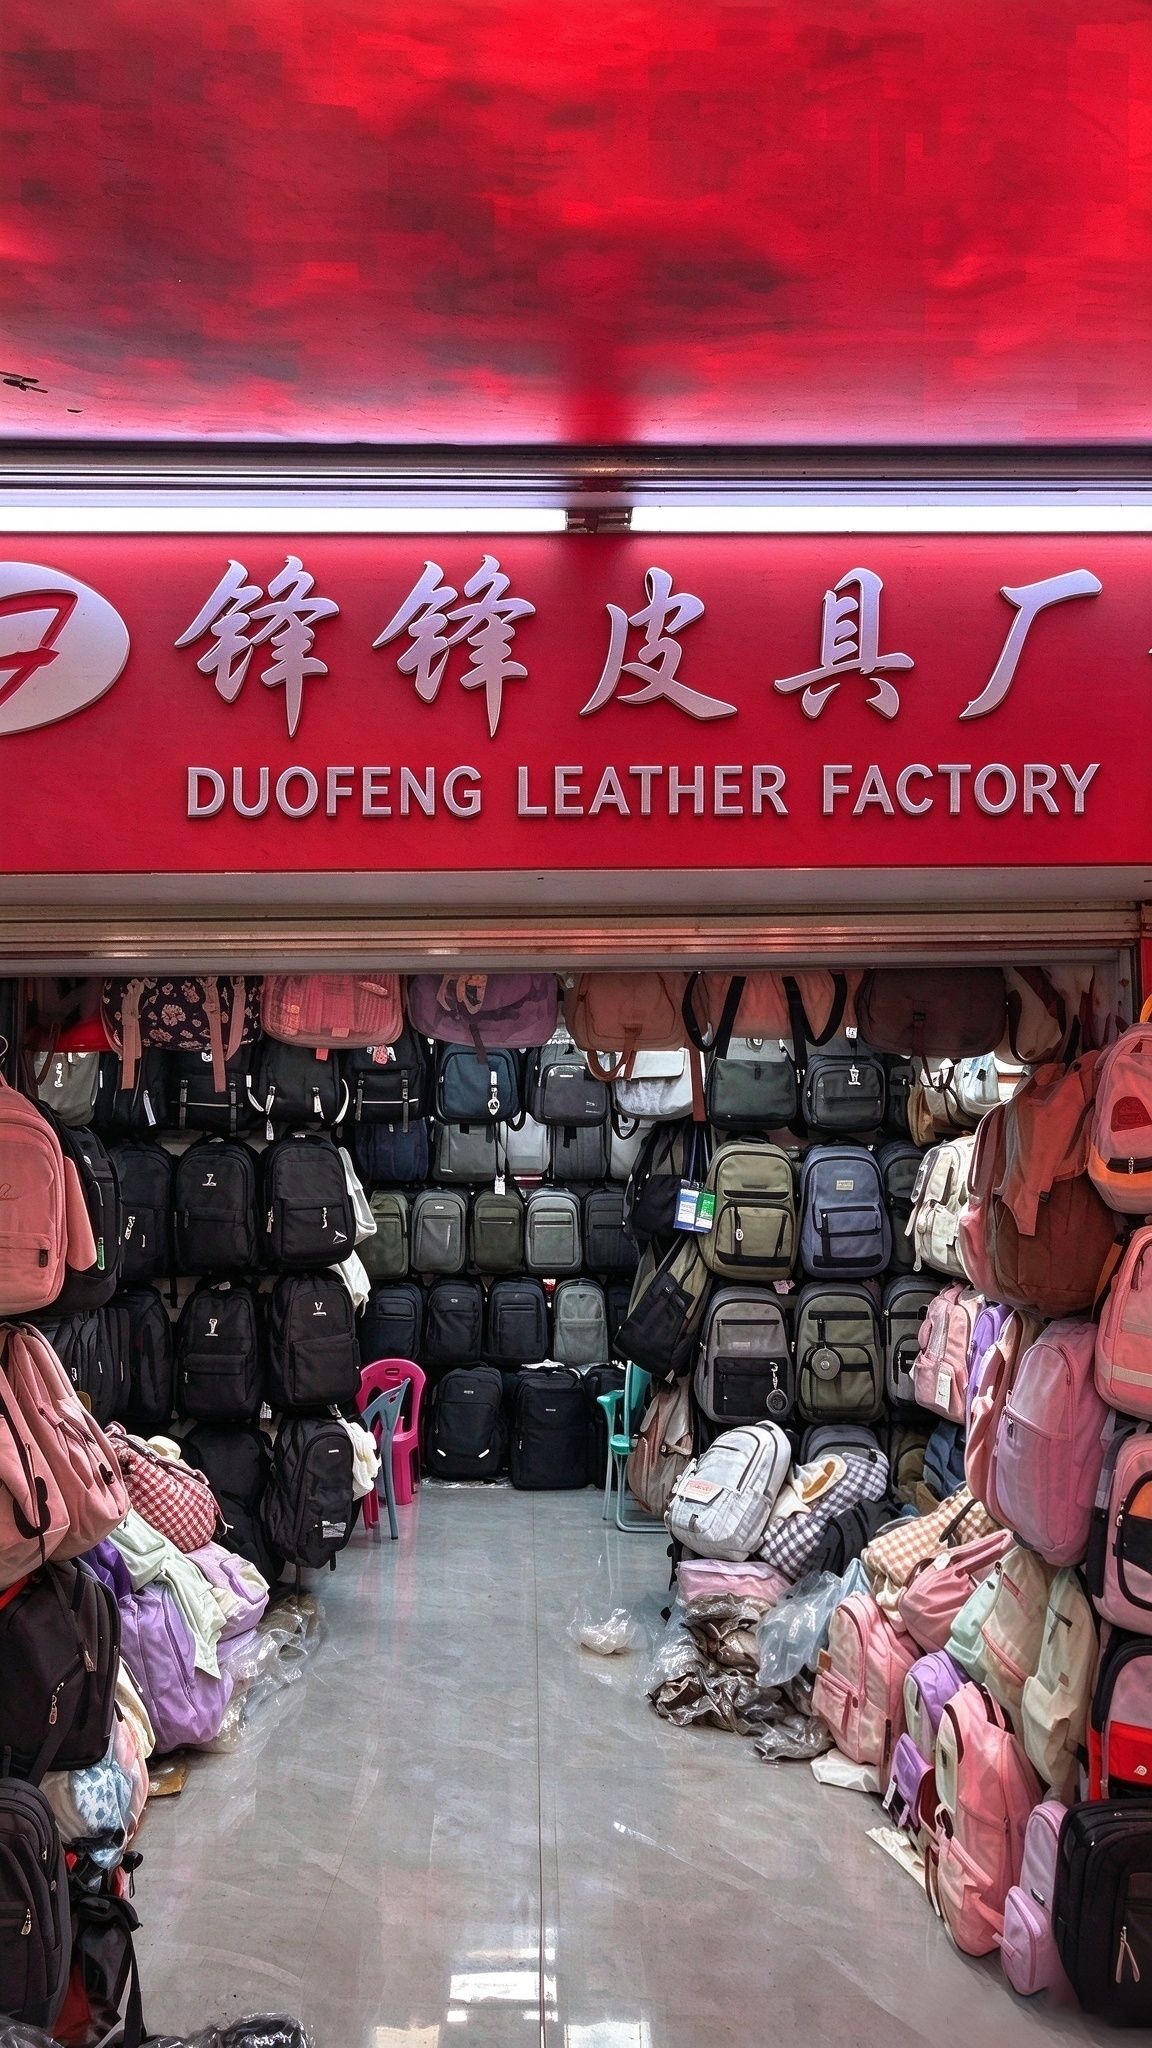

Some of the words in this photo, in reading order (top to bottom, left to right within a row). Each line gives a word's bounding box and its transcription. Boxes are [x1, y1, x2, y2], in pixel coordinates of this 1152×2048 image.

[186, 765, 483, 819] DUOFENG
[517, 764, 789, 817] LEATHER
[822, 763, 1101, 816] FACTORY
